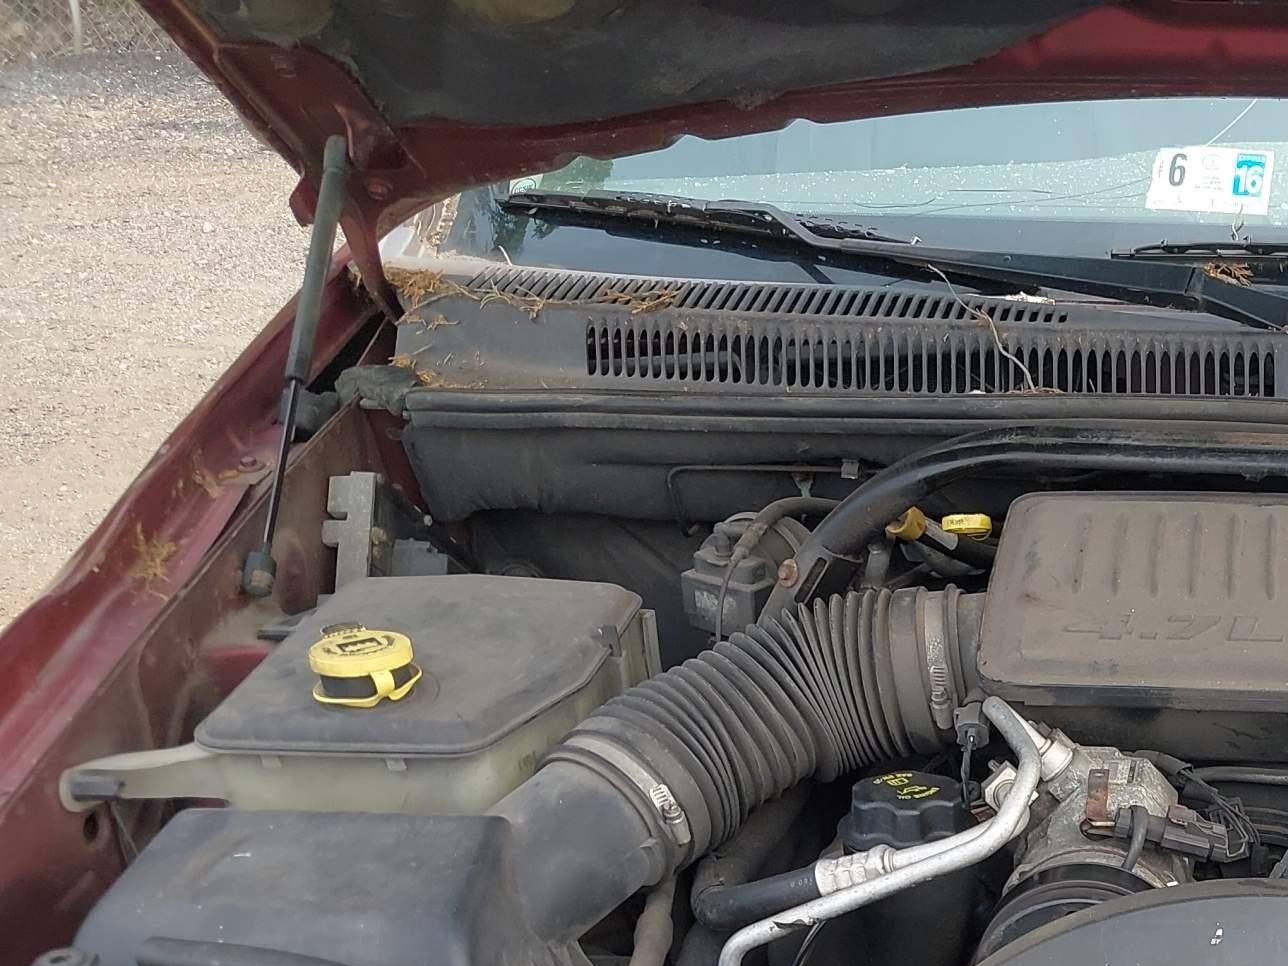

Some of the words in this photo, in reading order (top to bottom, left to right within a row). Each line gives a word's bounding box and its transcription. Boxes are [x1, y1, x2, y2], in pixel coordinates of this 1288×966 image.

[1168, 153, 1188, 187] 6
[1234, 162, 1264, 196] 16
[1061, 614, 1283, 643] 4.7L
